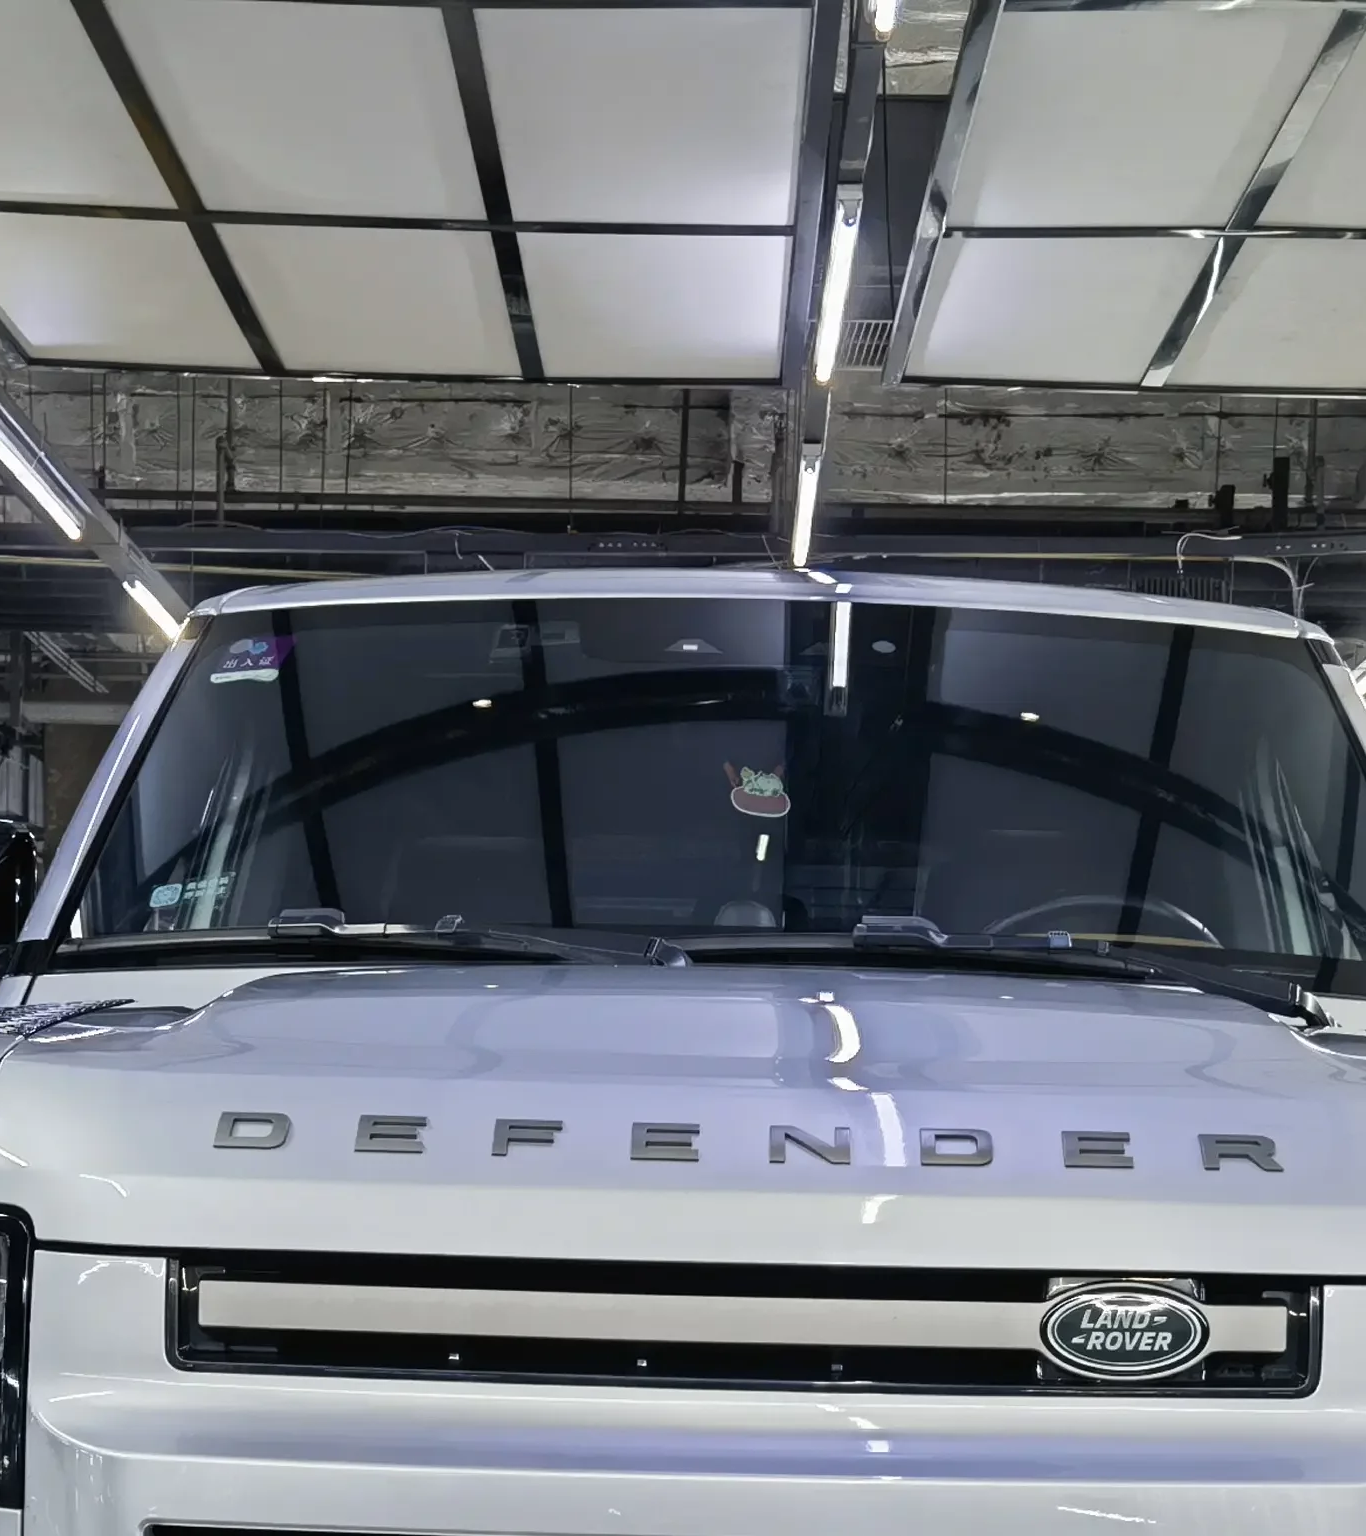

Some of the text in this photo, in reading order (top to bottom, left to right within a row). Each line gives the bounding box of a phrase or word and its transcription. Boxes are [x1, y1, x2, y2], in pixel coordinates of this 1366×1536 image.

[212, 1110, 1285, 1172] DEFENDER
[1080, 1310, 1151, 1329] LAND
[1086, 1331, 1172, 1351] ROVER
